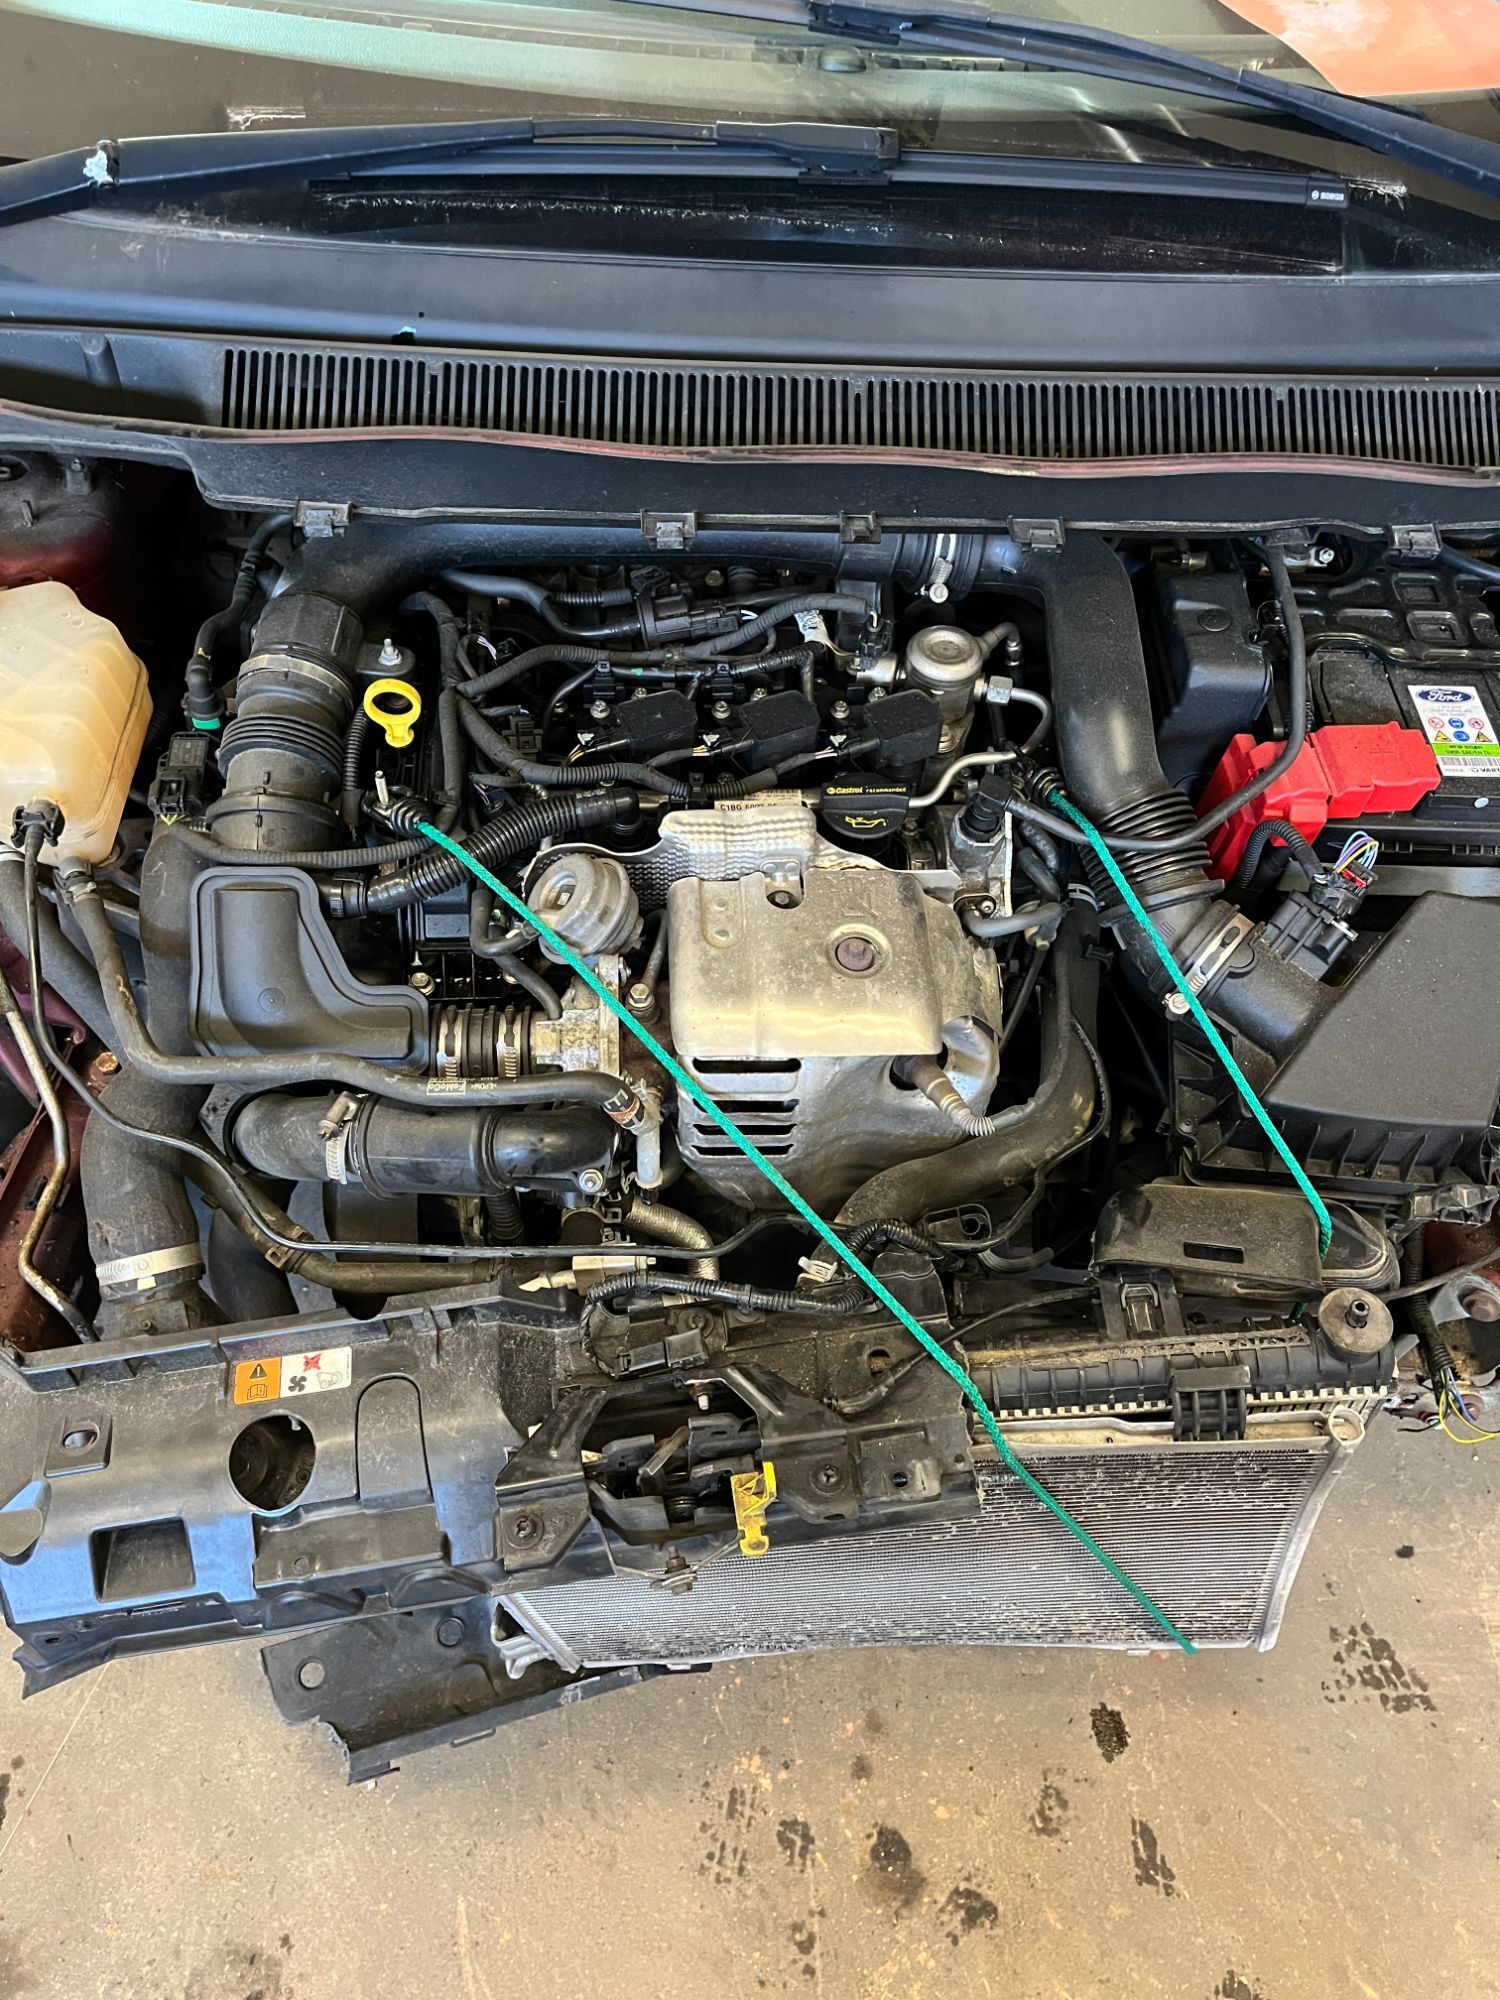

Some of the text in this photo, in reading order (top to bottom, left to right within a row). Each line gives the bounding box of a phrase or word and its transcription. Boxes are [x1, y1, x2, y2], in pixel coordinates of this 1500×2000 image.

[1428, 689, 1463, 701] Ford
[835, 786, 863, 795] Castrol
[429, 1082, 465, 1092] FoMoCo
